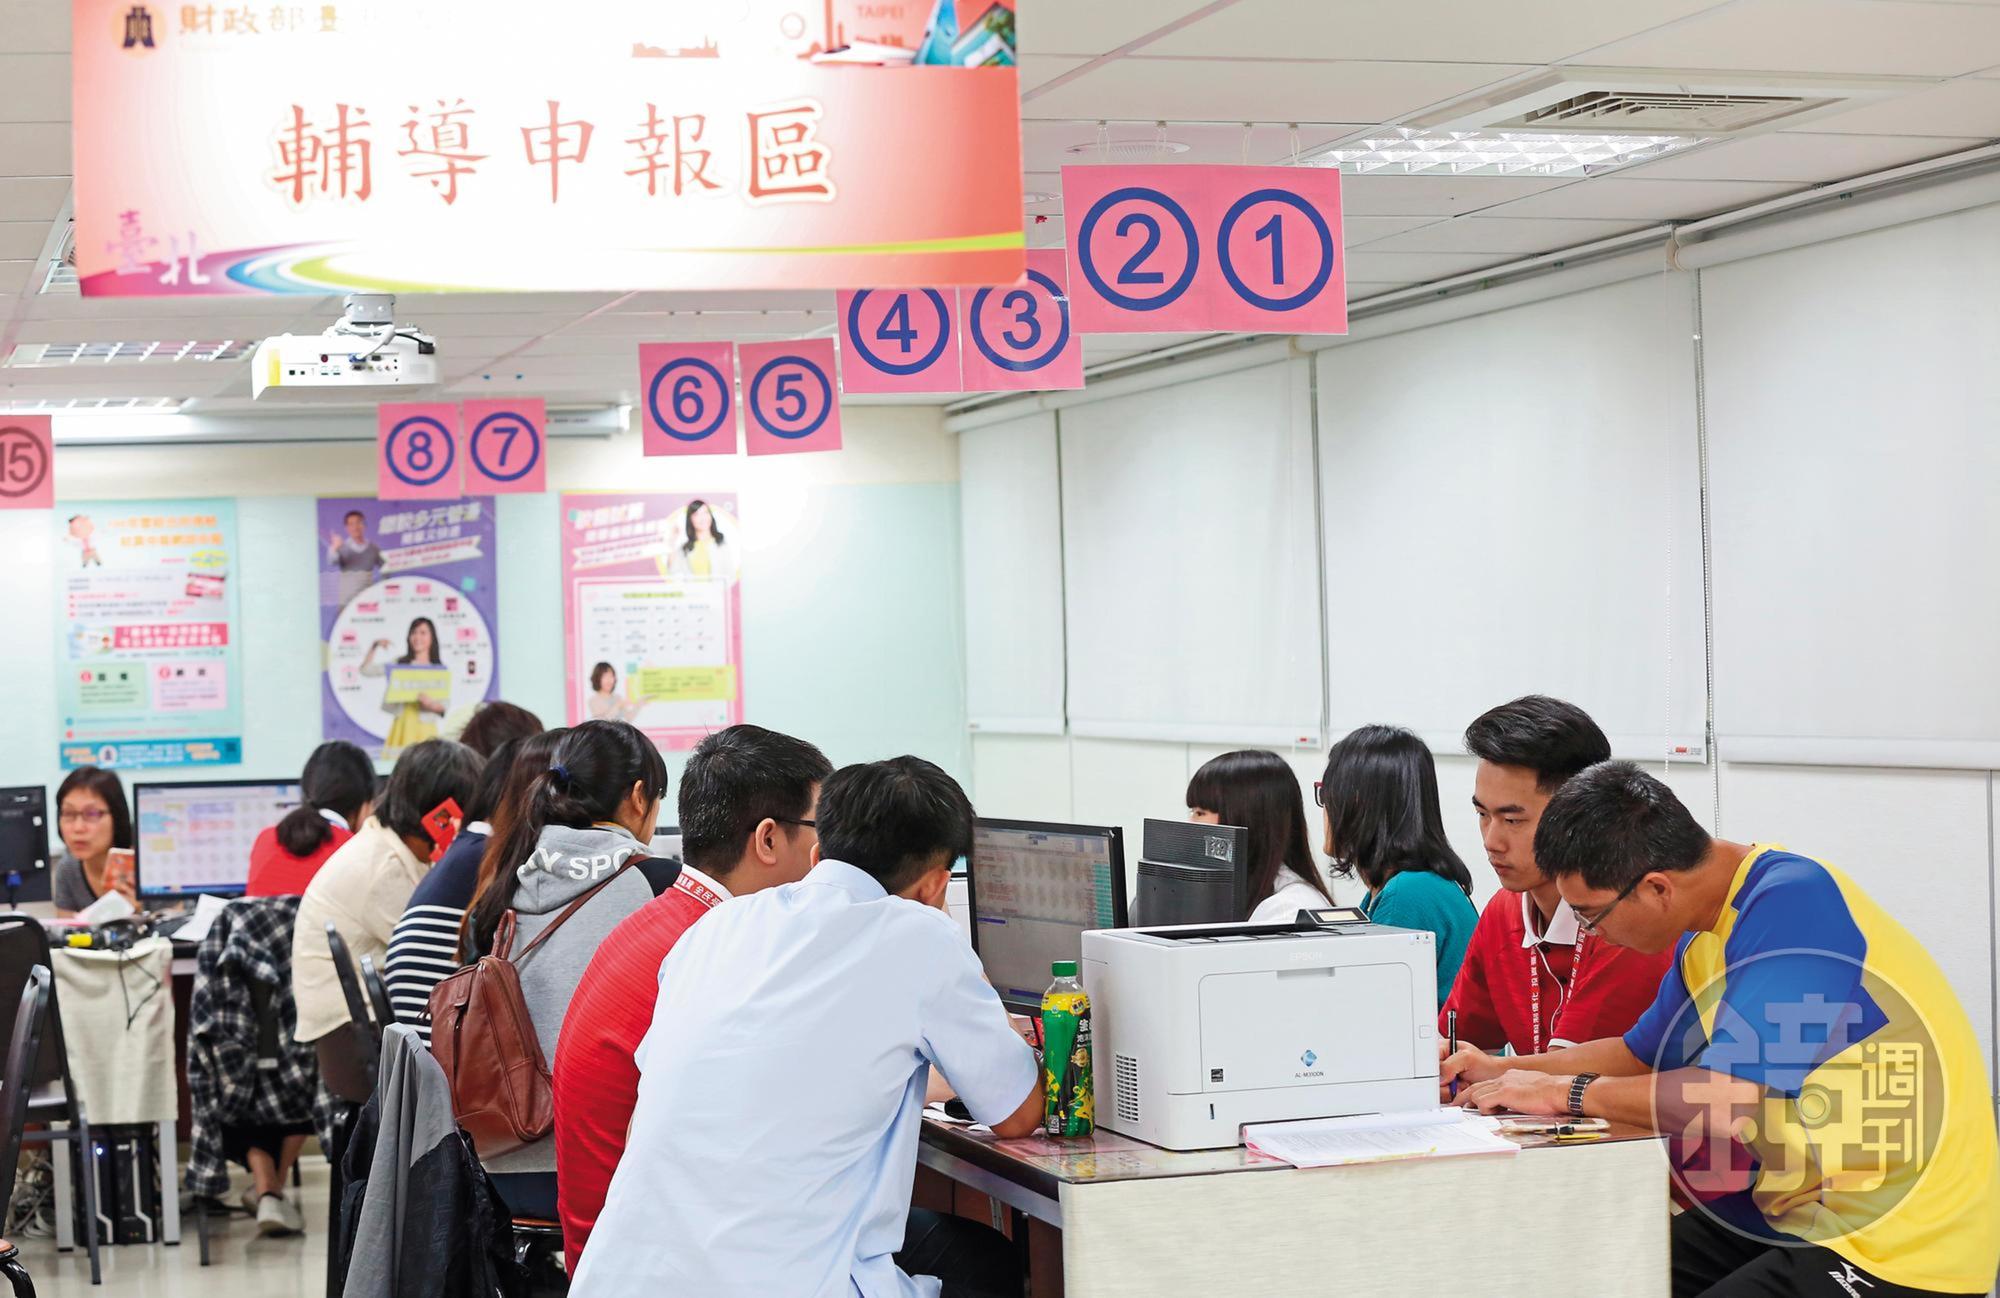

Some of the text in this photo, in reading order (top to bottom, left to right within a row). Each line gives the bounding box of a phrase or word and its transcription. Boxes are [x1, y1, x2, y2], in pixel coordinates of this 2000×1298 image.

[856, 5, 904, 20] TAIPEI
[272, 98, 829, 206] 輔導申報區
[106, 210, 212, 286] 臺北
[1115, 213, 1165, 284] 2
[1255, 214, 1285, 285] 1
[876, 293, 918, 353] 4
[1002, 290, 1042, 351] 3
[672, 375, 705, 424] 6
[775, 373, 808, 422] 5
[0, 442, 35, 483] 15
[406, 430, 434, 472] 8
[492, 427, 520, 467] 7
